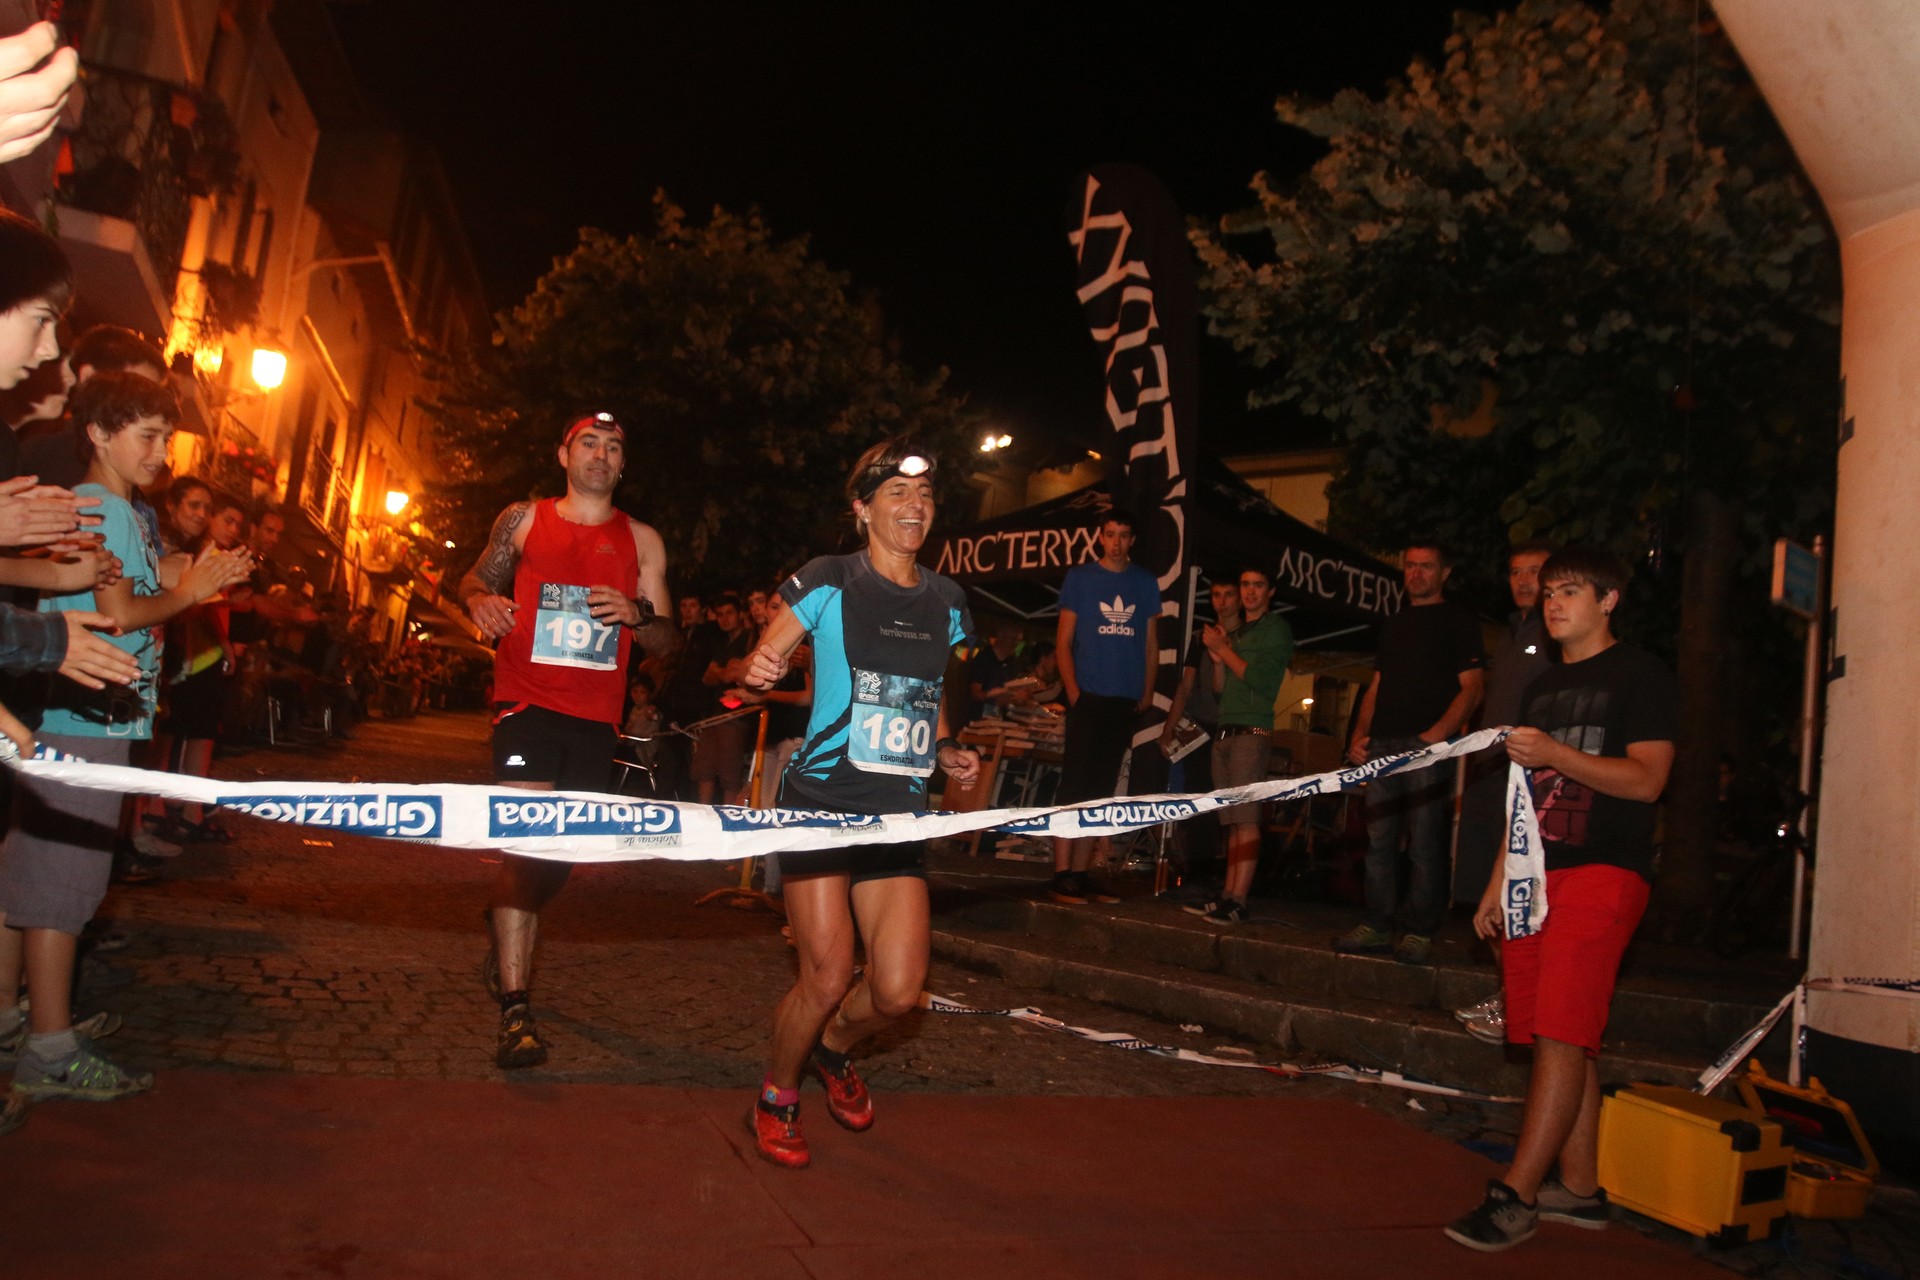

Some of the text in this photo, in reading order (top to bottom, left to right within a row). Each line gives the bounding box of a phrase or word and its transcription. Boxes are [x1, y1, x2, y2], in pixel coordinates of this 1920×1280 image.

[935, 526, 1102, 575] ARC'TERYX
[1276, 546, 1405, 617] ARC'TERY
[546, 617, 612, 652] 197
[1098, 624, 1136, 637] adidas
[862, 713, 930, 756] 180
[494, 801, 675, 834] Gipuzkoa
